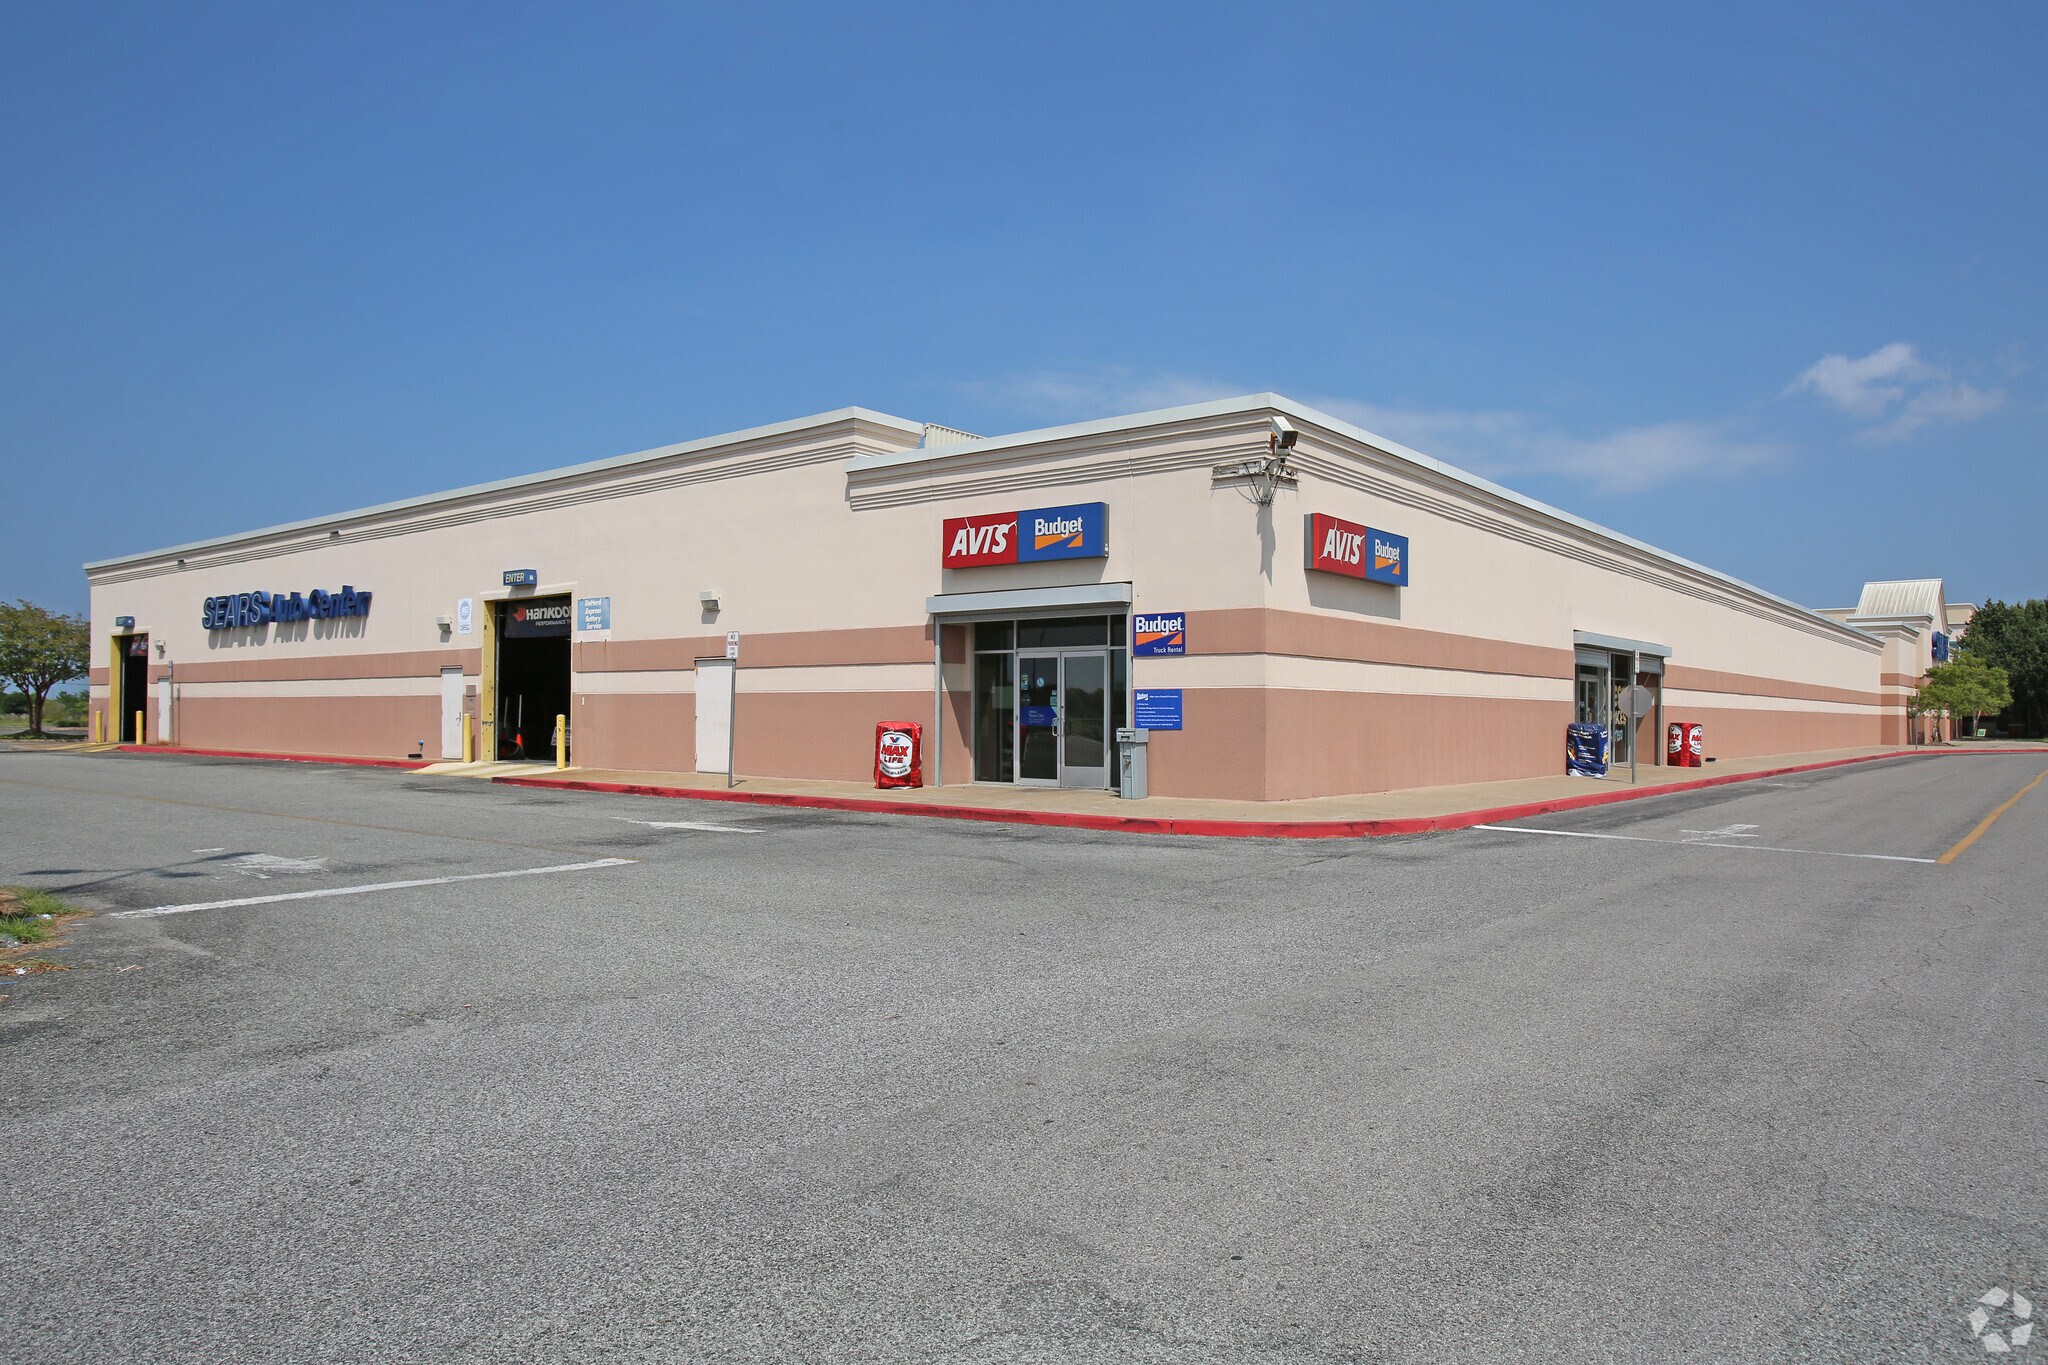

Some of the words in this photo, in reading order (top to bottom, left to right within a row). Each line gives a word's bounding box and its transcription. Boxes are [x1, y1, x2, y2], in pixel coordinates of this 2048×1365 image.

[949, 523, 1010, 556] AVIS
[1035, 516, 1083, 537] Budget
[1322, 528, 1362, 565] AVIS
[1374, 538, 1400, 563] Budget
[505, 572, 525, 583] ENTER
[202, 590, 271, 630] SEARS
[269, 592, 310, 622] Auto
[308, 585, 372, 619] Center
[526, 606, 572, 620] Hankoo
[586, 622, 602, 630] Service
[1135, 615, 1183, 636] Budget
[881, 744, 910, 757] MAX
